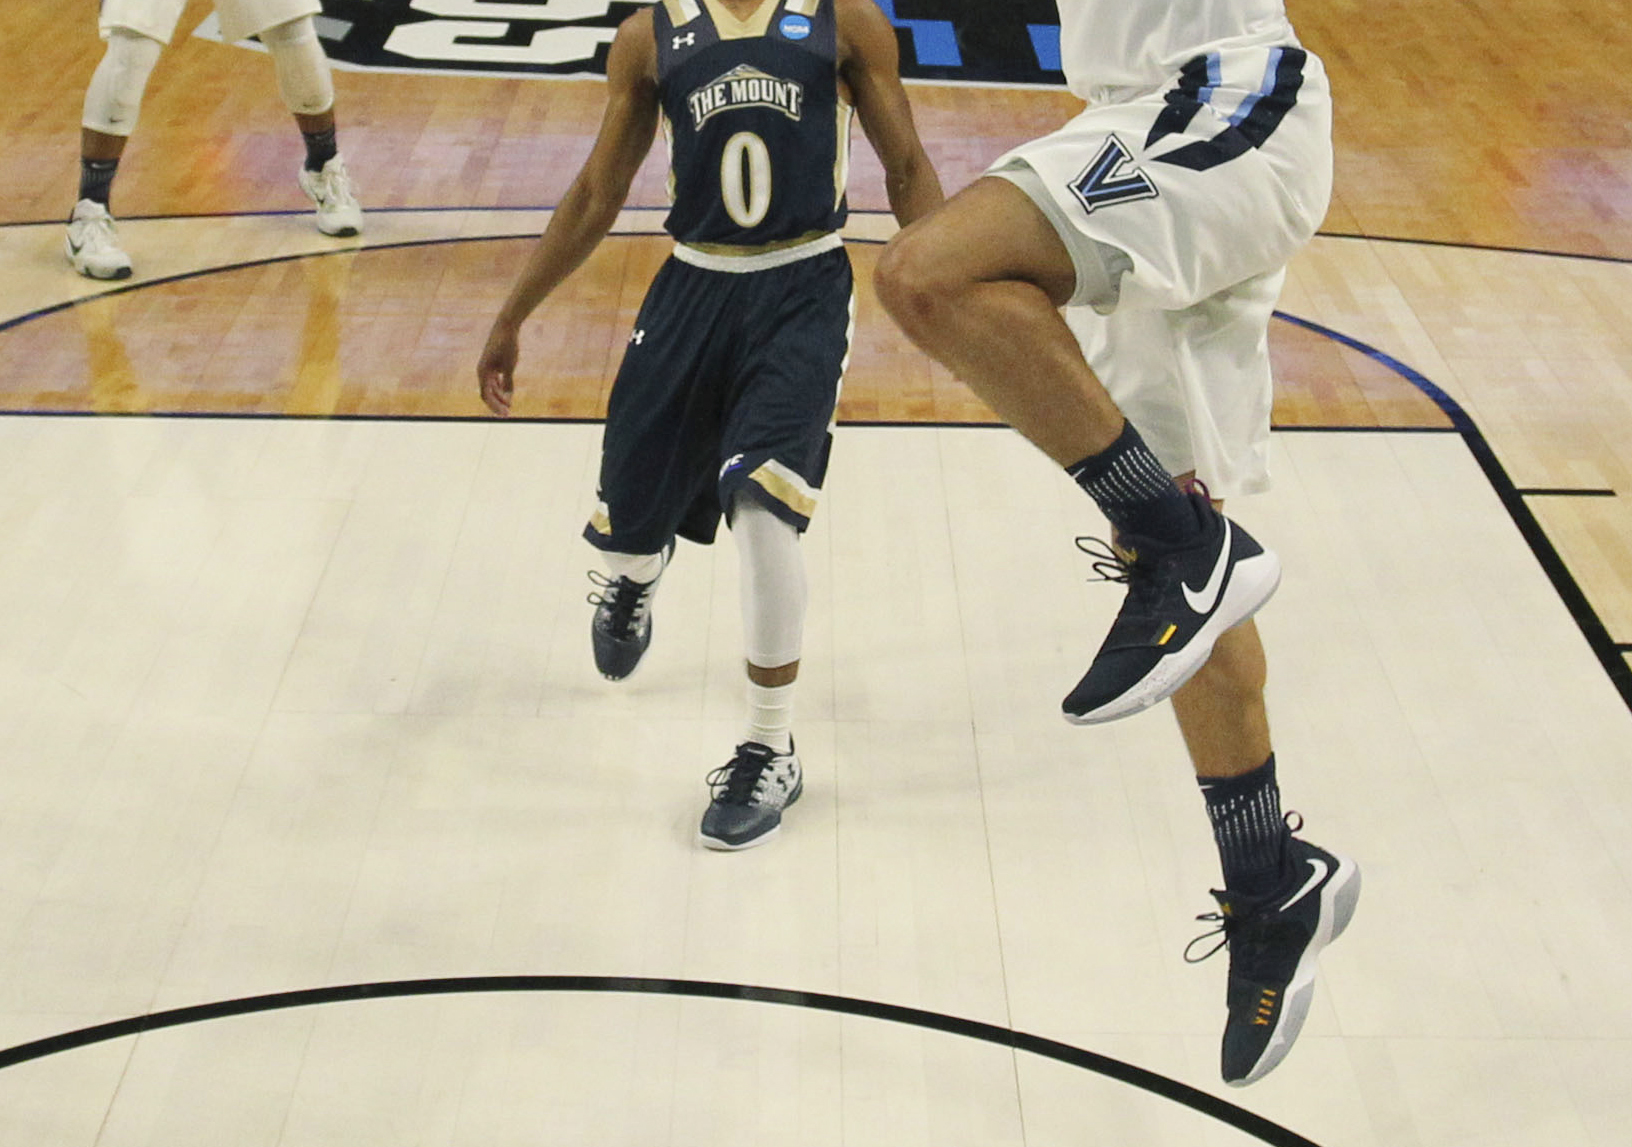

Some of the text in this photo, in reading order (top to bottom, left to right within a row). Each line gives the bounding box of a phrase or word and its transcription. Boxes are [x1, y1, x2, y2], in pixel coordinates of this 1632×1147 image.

[689, 79, 801, 124] THE MOUNT
[720, 130, 772, 228] 0
[1067, 132, 1159, 215] V
